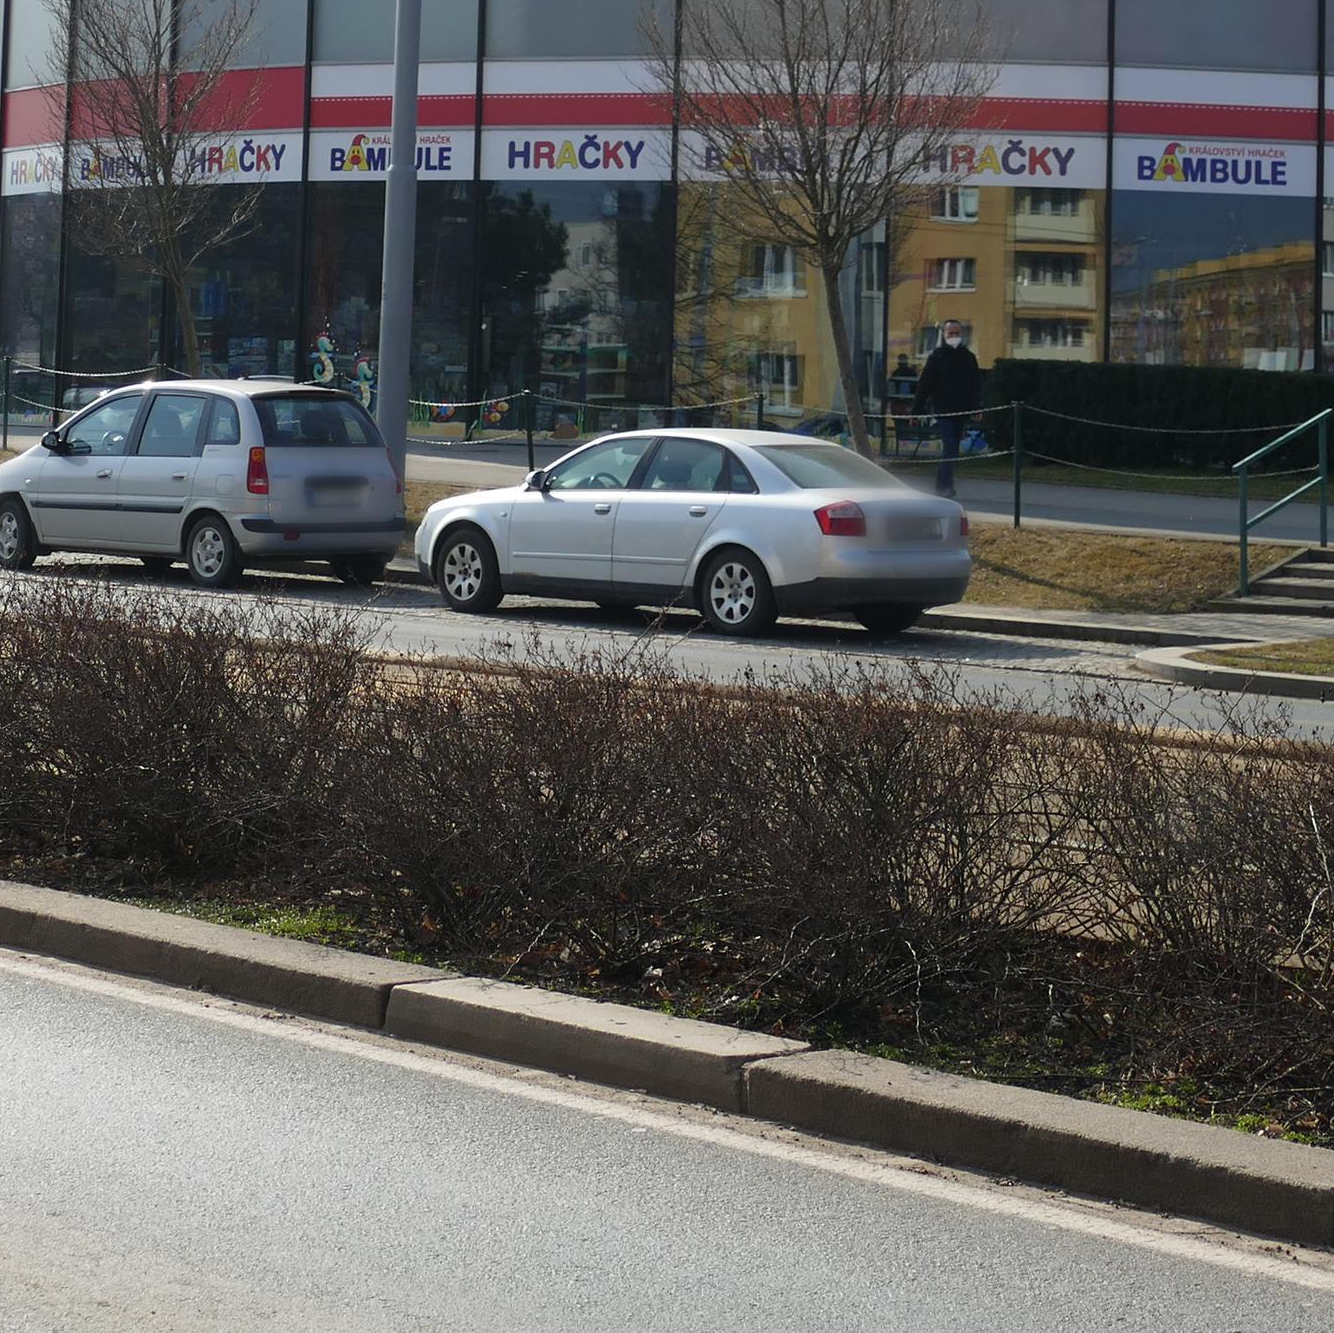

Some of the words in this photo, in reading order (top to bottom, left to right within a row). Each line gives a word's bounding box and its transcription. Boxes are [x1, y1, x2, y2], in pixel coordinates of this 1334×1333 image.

[189, 139, 286, 173] HRAČKY
[330, 144, 452, 171] BAMULE
[508, 134, 645, 170] HRAČKY
[923, 139, 1076, 177] HRAČKY
[1189, 146, 1245, 157] KRÁLOVSTVÍ
[1248, 147, 1285, 159] HRAČEK
[1137, 154, 1287, 186] BAMBULE
